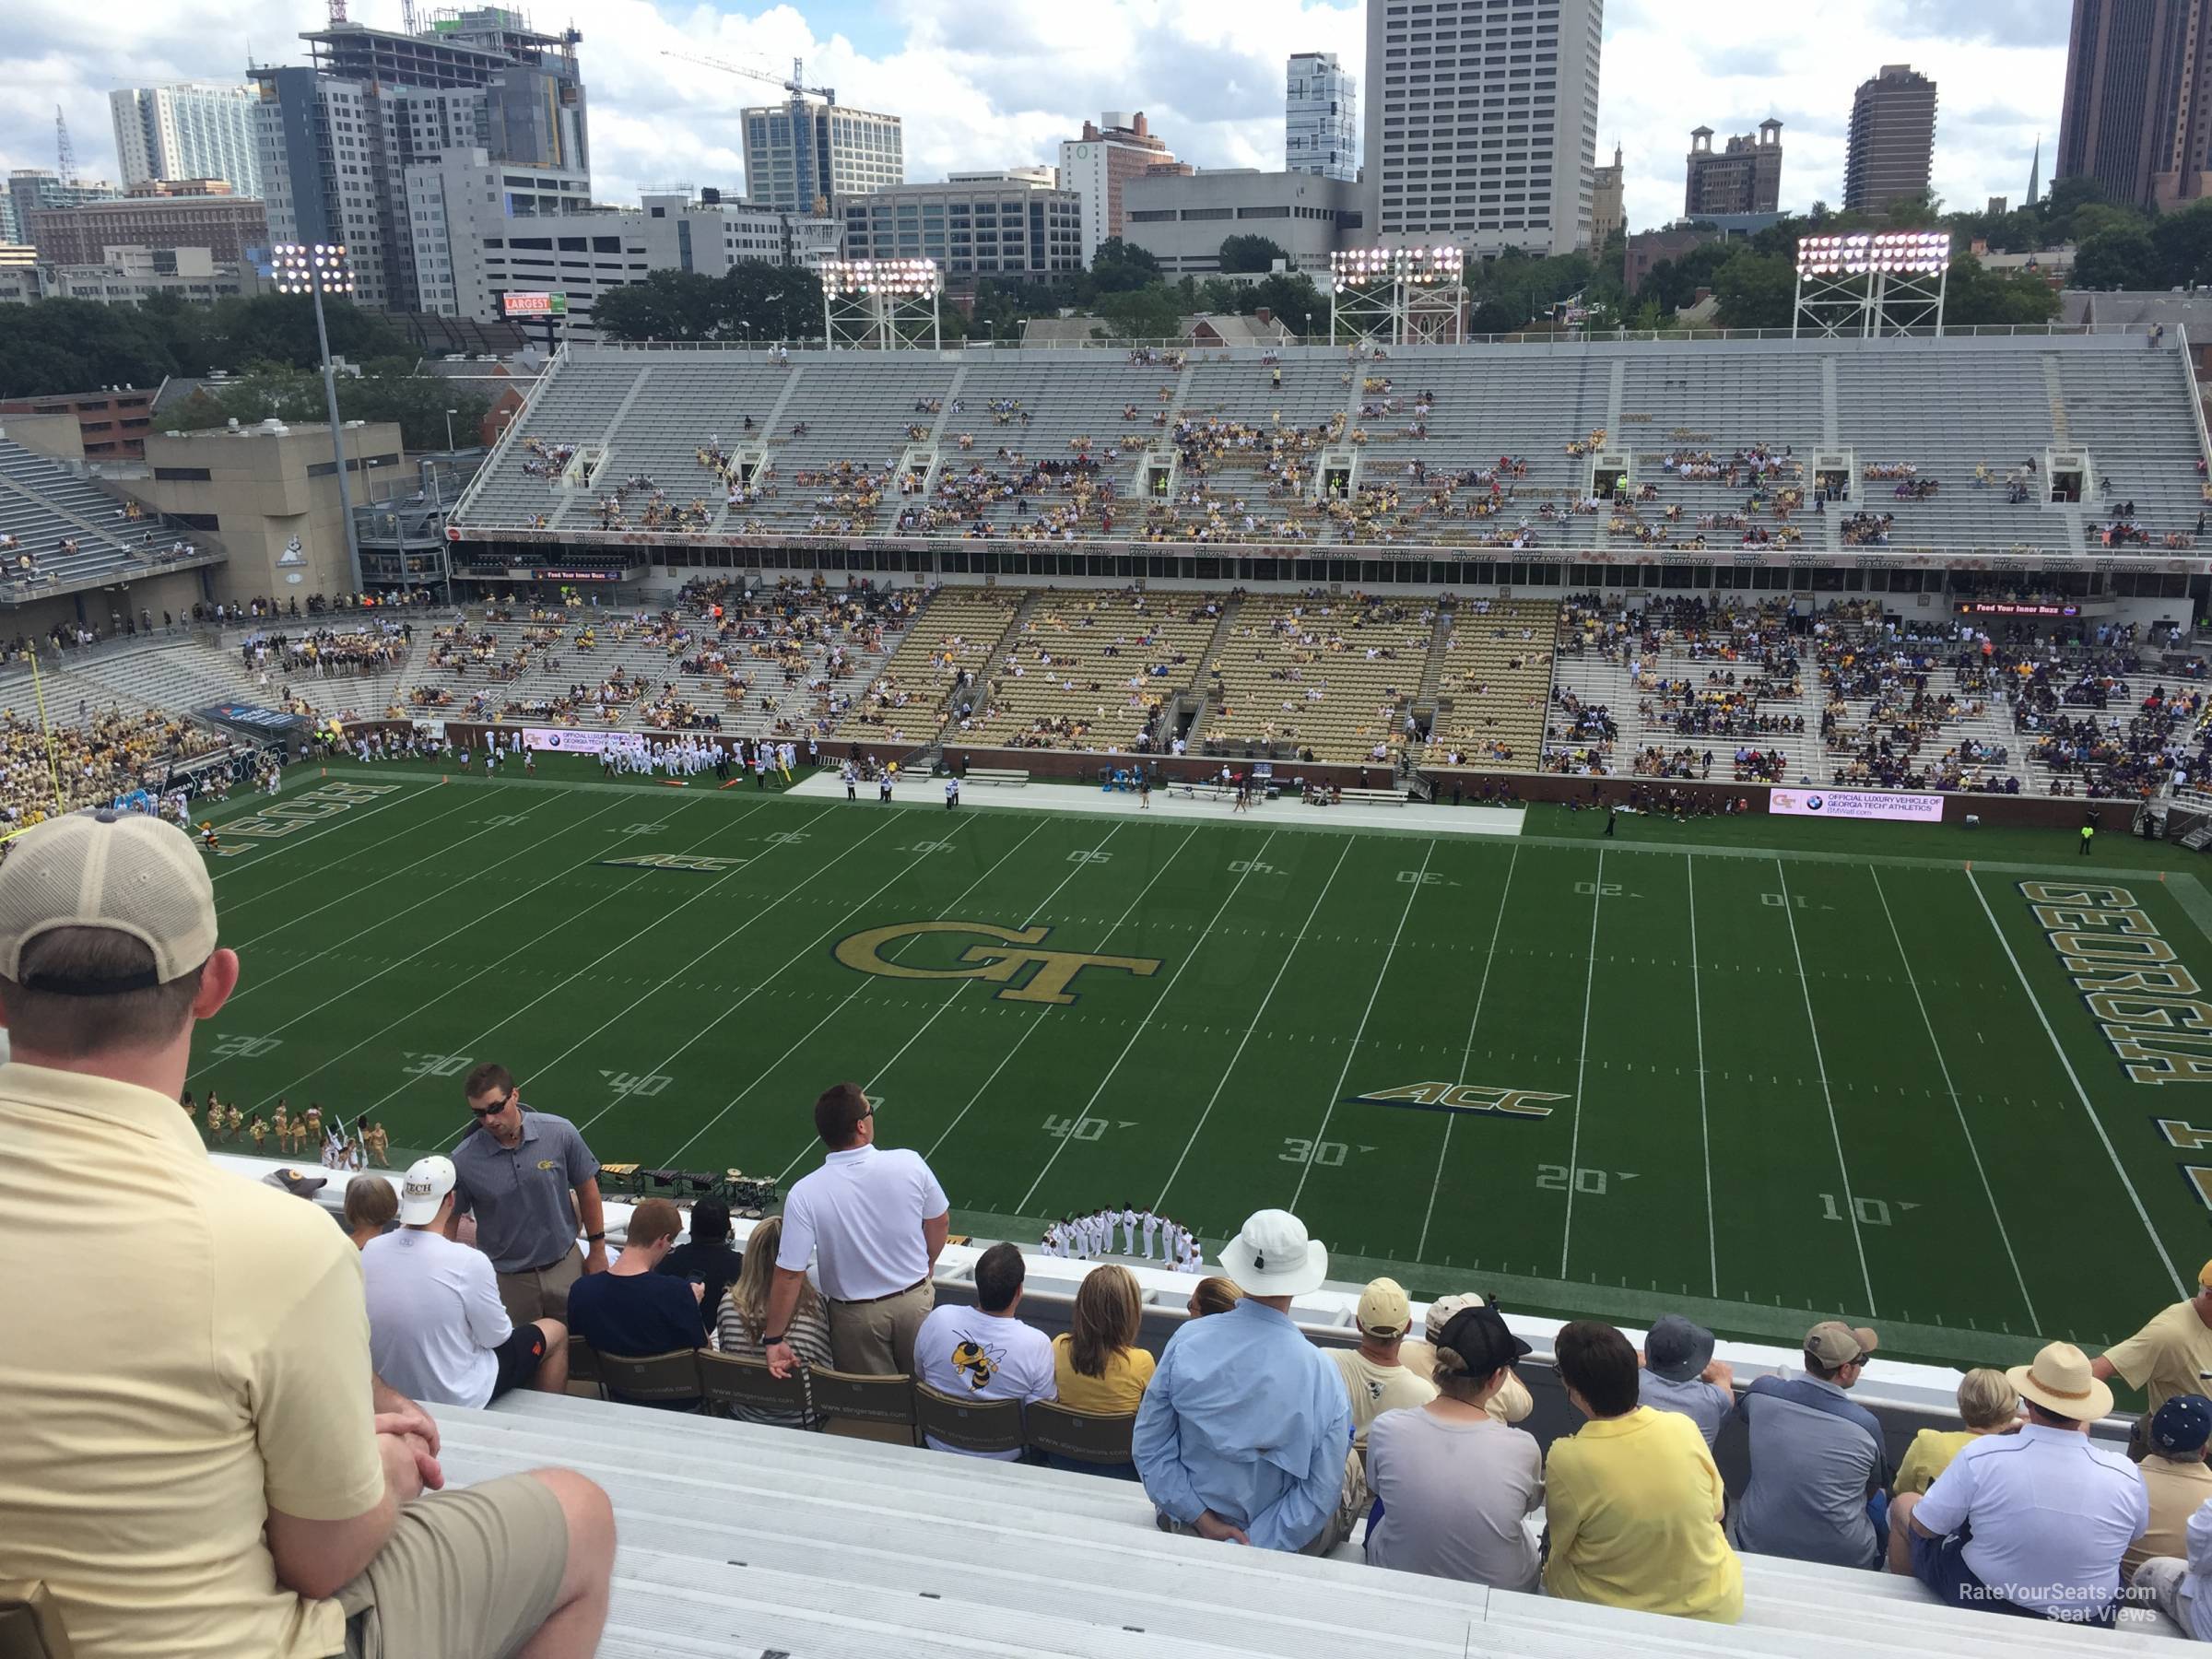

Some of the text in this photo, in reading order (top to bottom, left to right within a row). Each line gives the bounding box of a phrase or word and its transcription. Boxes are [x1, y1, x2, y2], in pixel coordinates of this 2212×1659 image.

[505, 299, 547, 309] LARGEST
[2096, 564, 2157, 572] SWILLING
[1977, 604, 1995, 612] Feed
[2016, 605, 2037, 613] Inner
[2039, 606, 2059, 614] Buzz
[1772, 794, 1796, 808] GT
[1828, 794, 1864, 802] OFFICIAL
[1894, 796, 1929, 805] VEHICLE
[1888, 803, 1932, 812] ATHLETICS
[483, 815, 530, 826] 10
[621, 823, 669, 834] 20
[763, 832, 811, 844] 30
[912, 841, 957, 853] 40
[602, 853, 748, 871] ACC
[1065, 850, 1113, 864] 50
[1227, 860, 1274, 876] 40
[1396, 871, 1443, 886] 30
[1573, 881, 1623, 897] 20
[1760, 892, 1807, 909] 10
[832, 920, 1165, 1006] GT
[2018, 881, 2212, 1085] GEORGIA
[210, 1036, 283, 1058] 20
[403, 1053, 474, 1077] 30
[607, 1072, 674, 1097] 40
[1358, 1081, 1571, 1116] ACC
[1041, 1113, 1109, 1141] 40
[1278, 1137, 1348, 1167] 30
[406, 1182, 431, 1192] TECH
[1535, 1164, 1607, 1195] 20
[1818, 1194, 1891, 1227] 10
[820, 1403, 907, 1419] www.stingerseats.com
[1038, 1435, 1129, 1456] www.stingerseats.com
